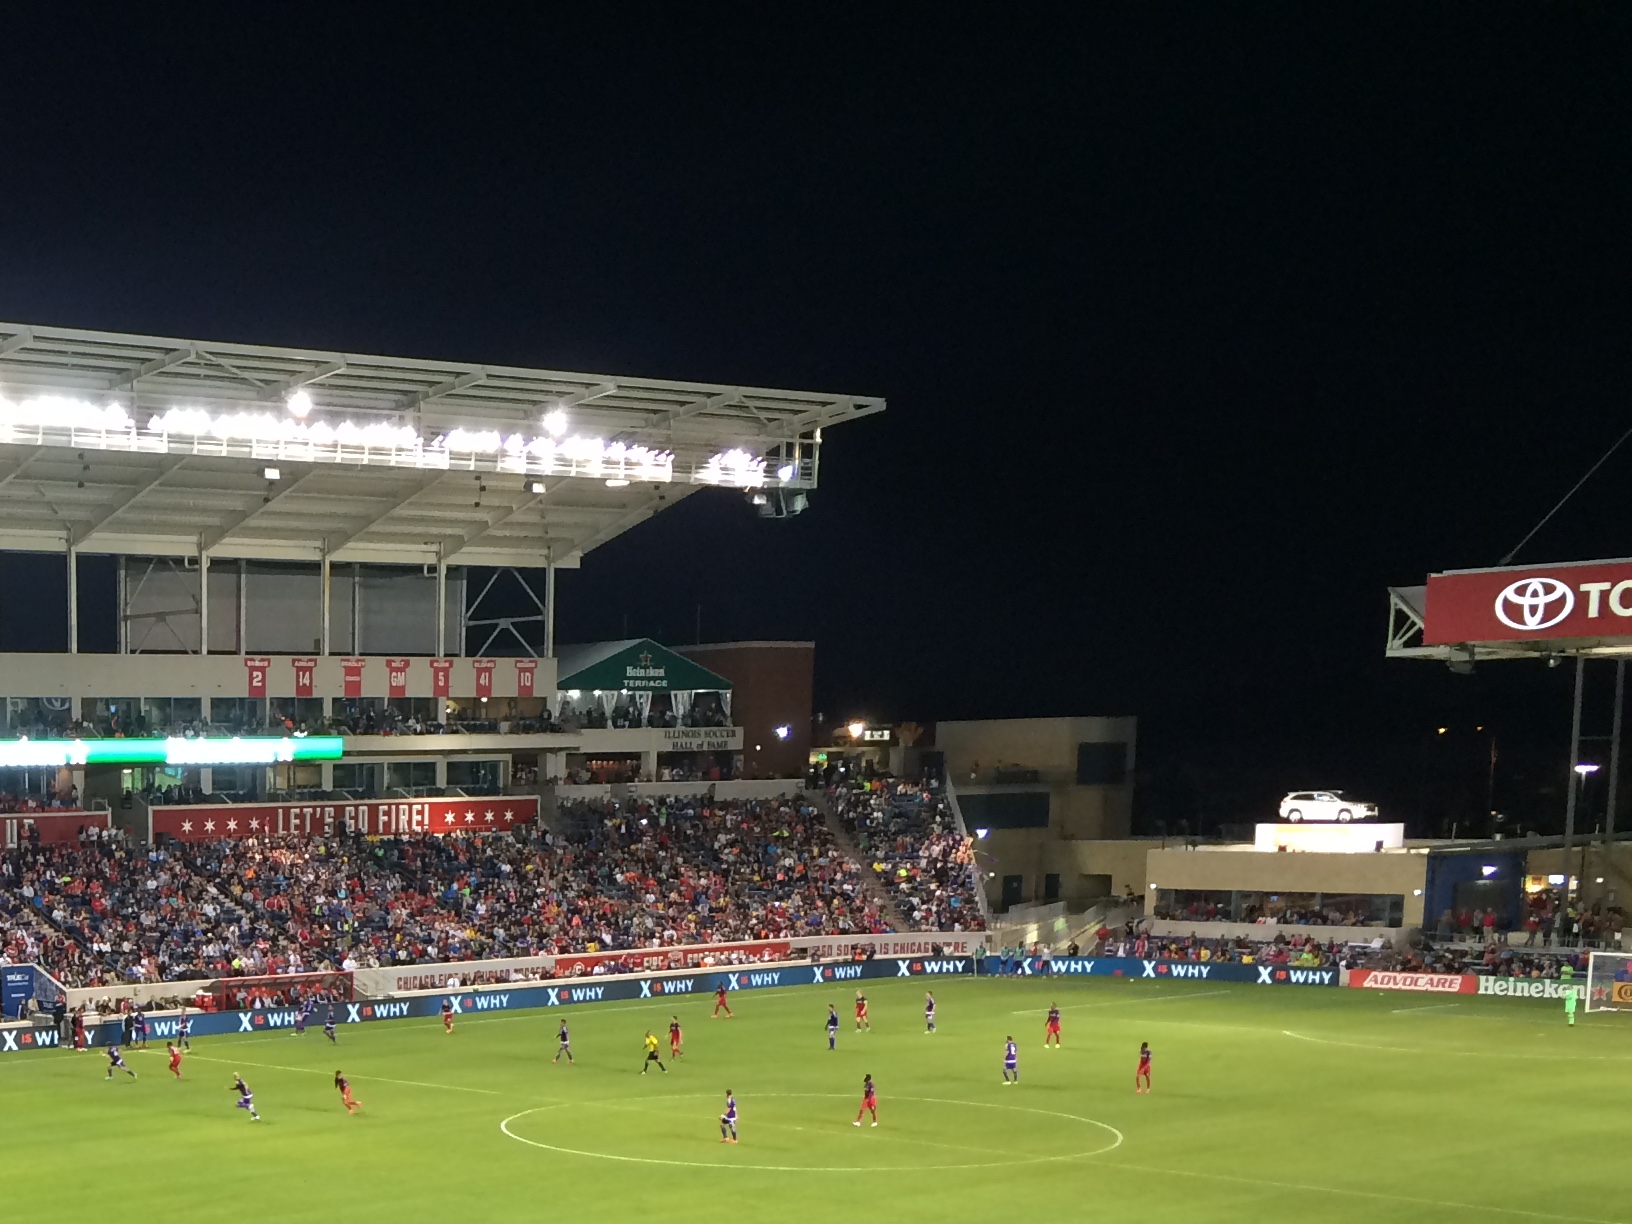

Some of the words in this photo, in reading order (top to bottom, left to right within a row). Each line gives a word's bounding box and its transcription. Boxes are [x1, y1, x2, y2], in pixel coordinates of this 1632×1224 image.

[252, 671, 262, 687] 2
[298, 671, 310, 687] 14
[391, 672, 405, 687] GM
[438, 672, 445, 686] 5
[480, 672, 489, 687] 41
[521, 672, 531, 686] 10
[664, 730, 701, 738] ILLINOIS
[704, 729, 736, 738] SOCCER
[672, 742, 694, 750] HALL
[707, 741, 728, 749] FAME
[277, 807, 334, 839] LET'S
[378, 803, 429, 835] FIRE!
[813, 966, 824, 983] X
[825, 968, 832, 977] IS
[835, 965, 862, 979] WHY
[897, 960, 910, 976] X
[912, 962, 921, 970] IS
[924, 960, 966, 973] WHY
[1050, 960, 1094, 973] WHY
[1142, 961, 1156, 978] X
[1158, 965, 1168, 973] IS
[1171, 965, 1210, 979] WHY
[1257, 966, 1272, 984] X
[1276, 971, 1286, 980] IS
[1289, 969, 1333, 984] WHY
[640, 980, 651, 998] X
[653, 984, 662, 993] IS
[663, 978, 694, 993] WHY
[728, 973, 740, 990] X
[740, 976, 748, 984] IS
[751, 972, 780, 986] WHY
[1365, 973, 1462, 991] ADVOCARE
[1478, 976, 1586, 1000] Heineken
[449, 995, 462, 1014] X
[464, 999, 473, 1007] IS
[475, 993, 509, 1009] WHY
[547, 988, 559, 1006] X
[561, 991, 569, 1000] IS
[572, 986, 604, 1002] WHY
[346, 1003, 360, 1023] X
[362, 1006, 372, 1016] IS
[374, 1001, 410, 1018] WHY
[238, 1011, 253, 1032] X
[254, 1015, 264, 1025] IS
[2, 1030, 18, 1051] X
[21, 1033, 32, 1044] IS
